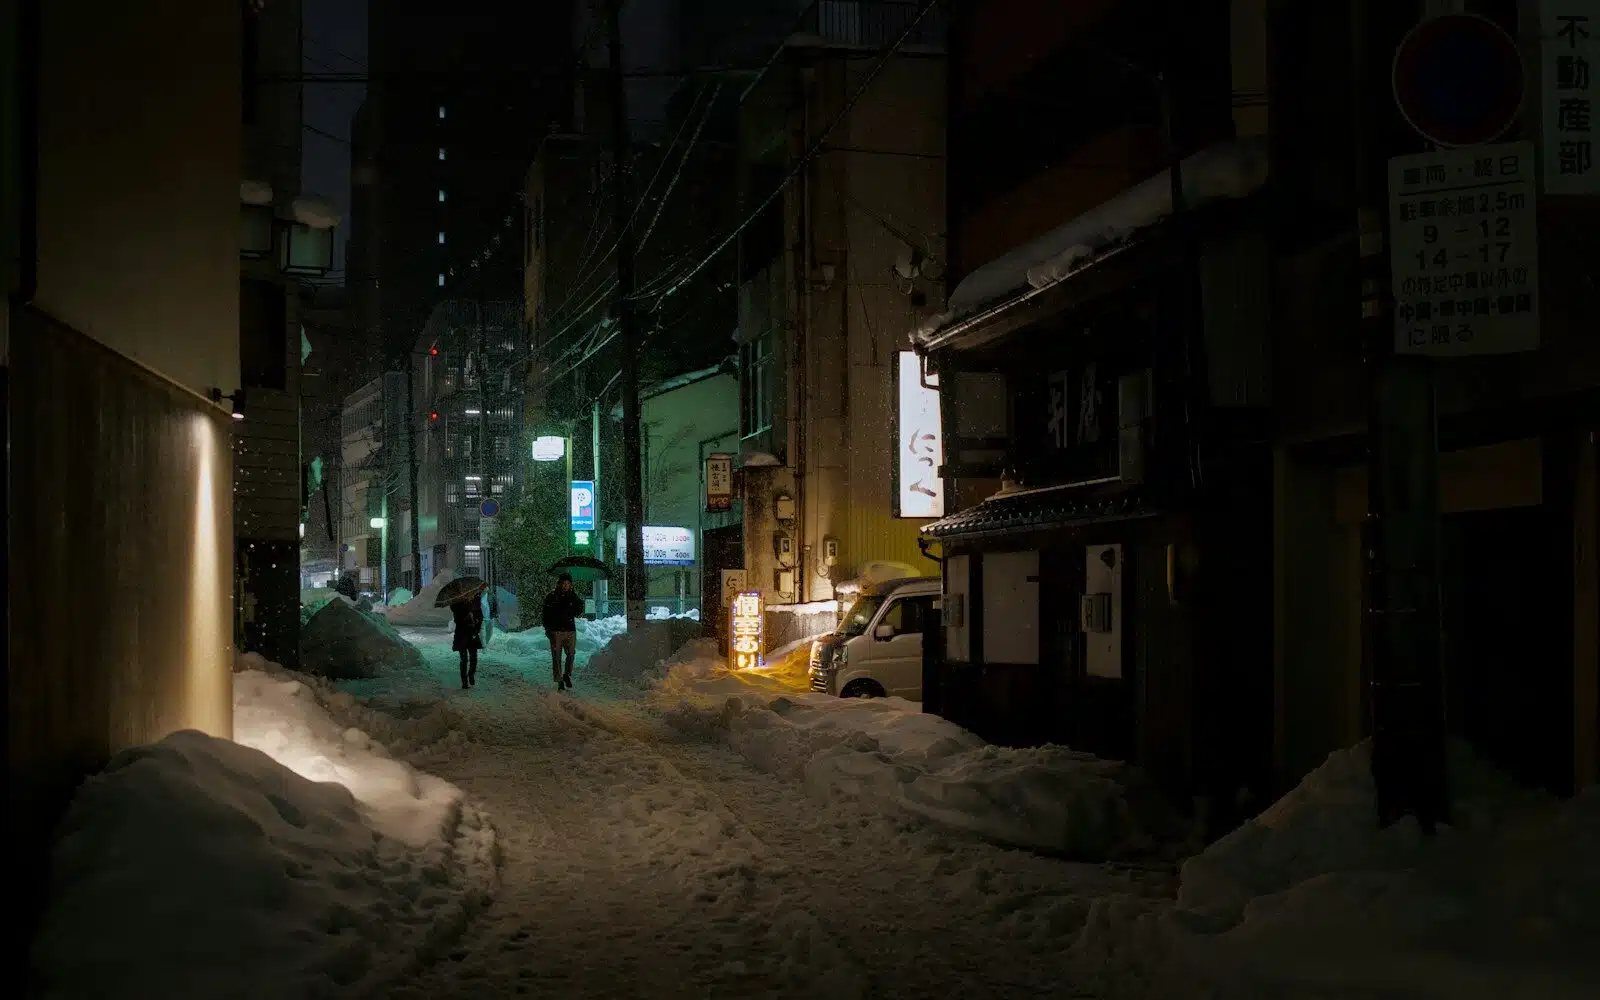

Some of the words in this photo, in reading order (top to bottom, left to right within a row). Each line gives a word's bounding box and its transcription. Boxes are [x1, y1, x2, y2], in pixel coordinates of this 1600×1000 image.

[1556, 15, 1591, 175] 不動産部
[571, 488, 592, 517] P
